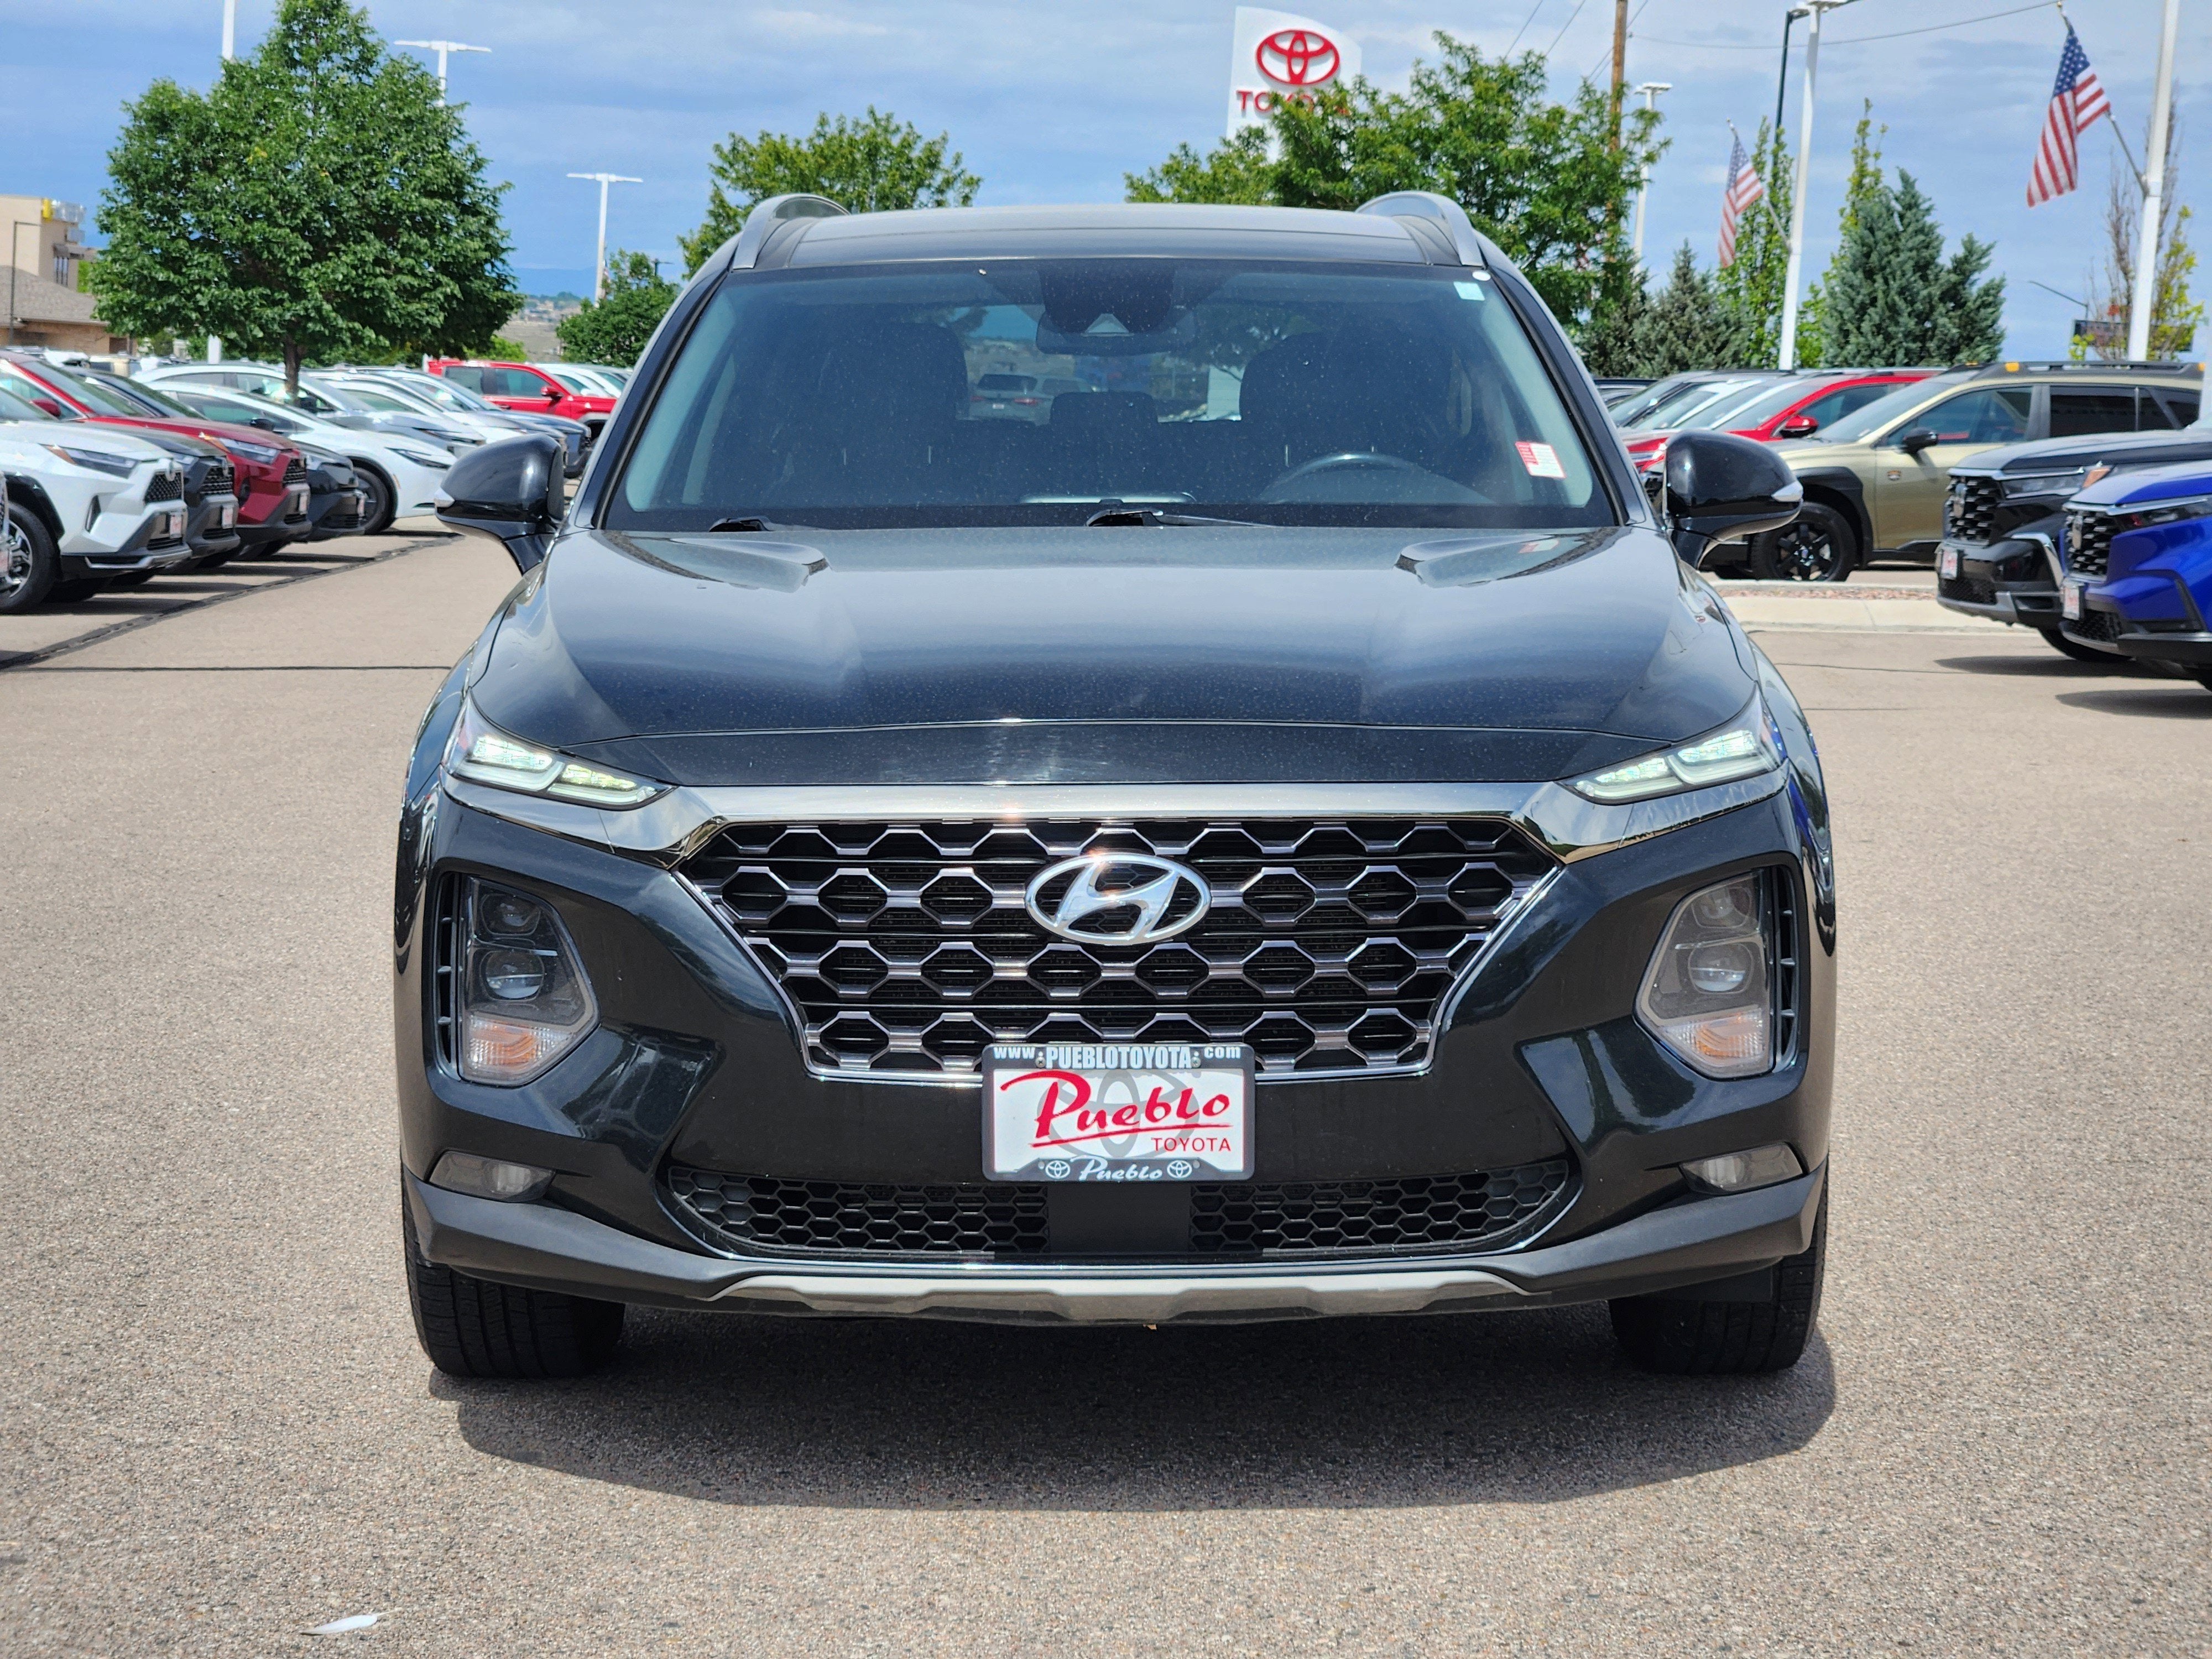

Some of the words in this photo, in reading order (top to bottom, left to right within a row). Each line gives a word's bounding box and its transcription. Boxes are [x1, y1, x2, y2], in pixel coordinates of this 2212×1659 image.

[1000, 1070, 1230, 1138] Pueblo
[1151, 1138, 1231, 1152] TOYOTA
[1070, 1155, 1162, 1181] Pueblo
